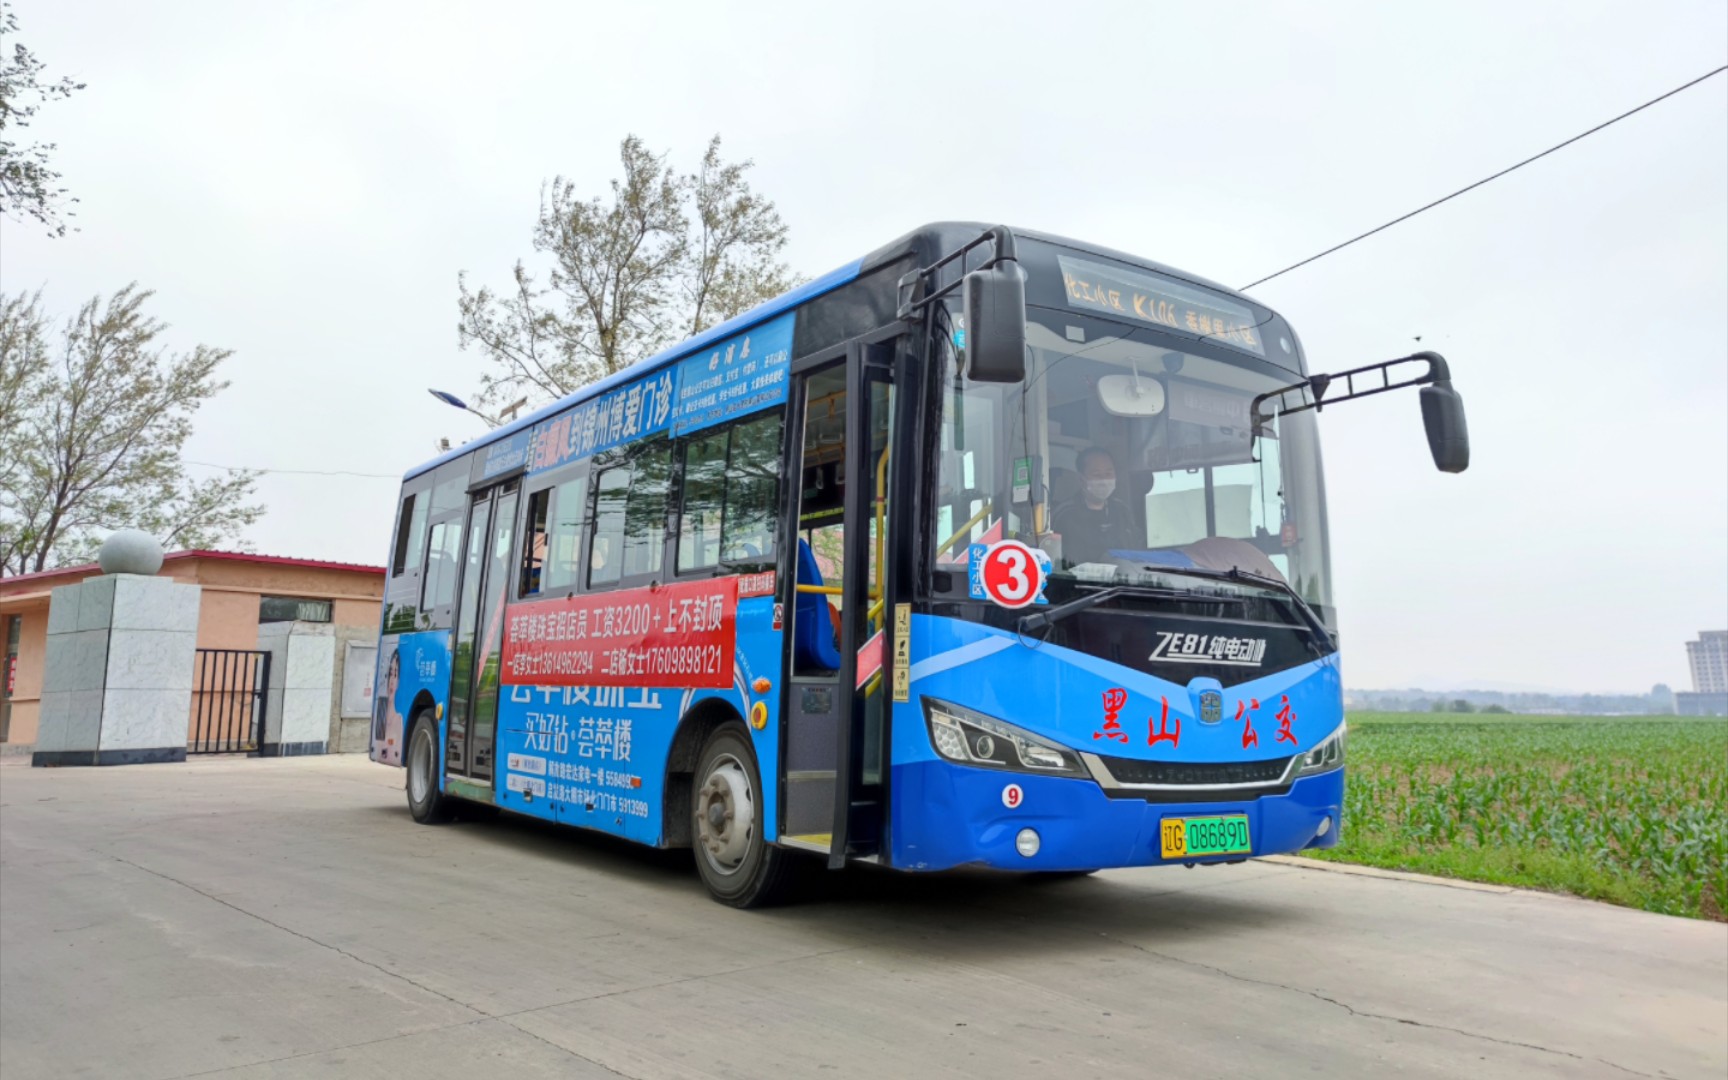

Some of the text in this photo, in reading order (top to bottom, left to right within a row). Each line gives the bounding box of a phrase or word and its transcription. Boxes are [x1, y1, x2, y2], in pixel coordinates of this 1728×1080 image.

[1066, 273, 1125, 311] 化工小区
[1133, 293, 1178, 328] K106
[972, 547, 984, 595] 化工小区
[996, 548, 1030, 600] 3
[1008, 787, 1019, 806] 9
[1163, 820, 1249, 852] 辽G 08689D
